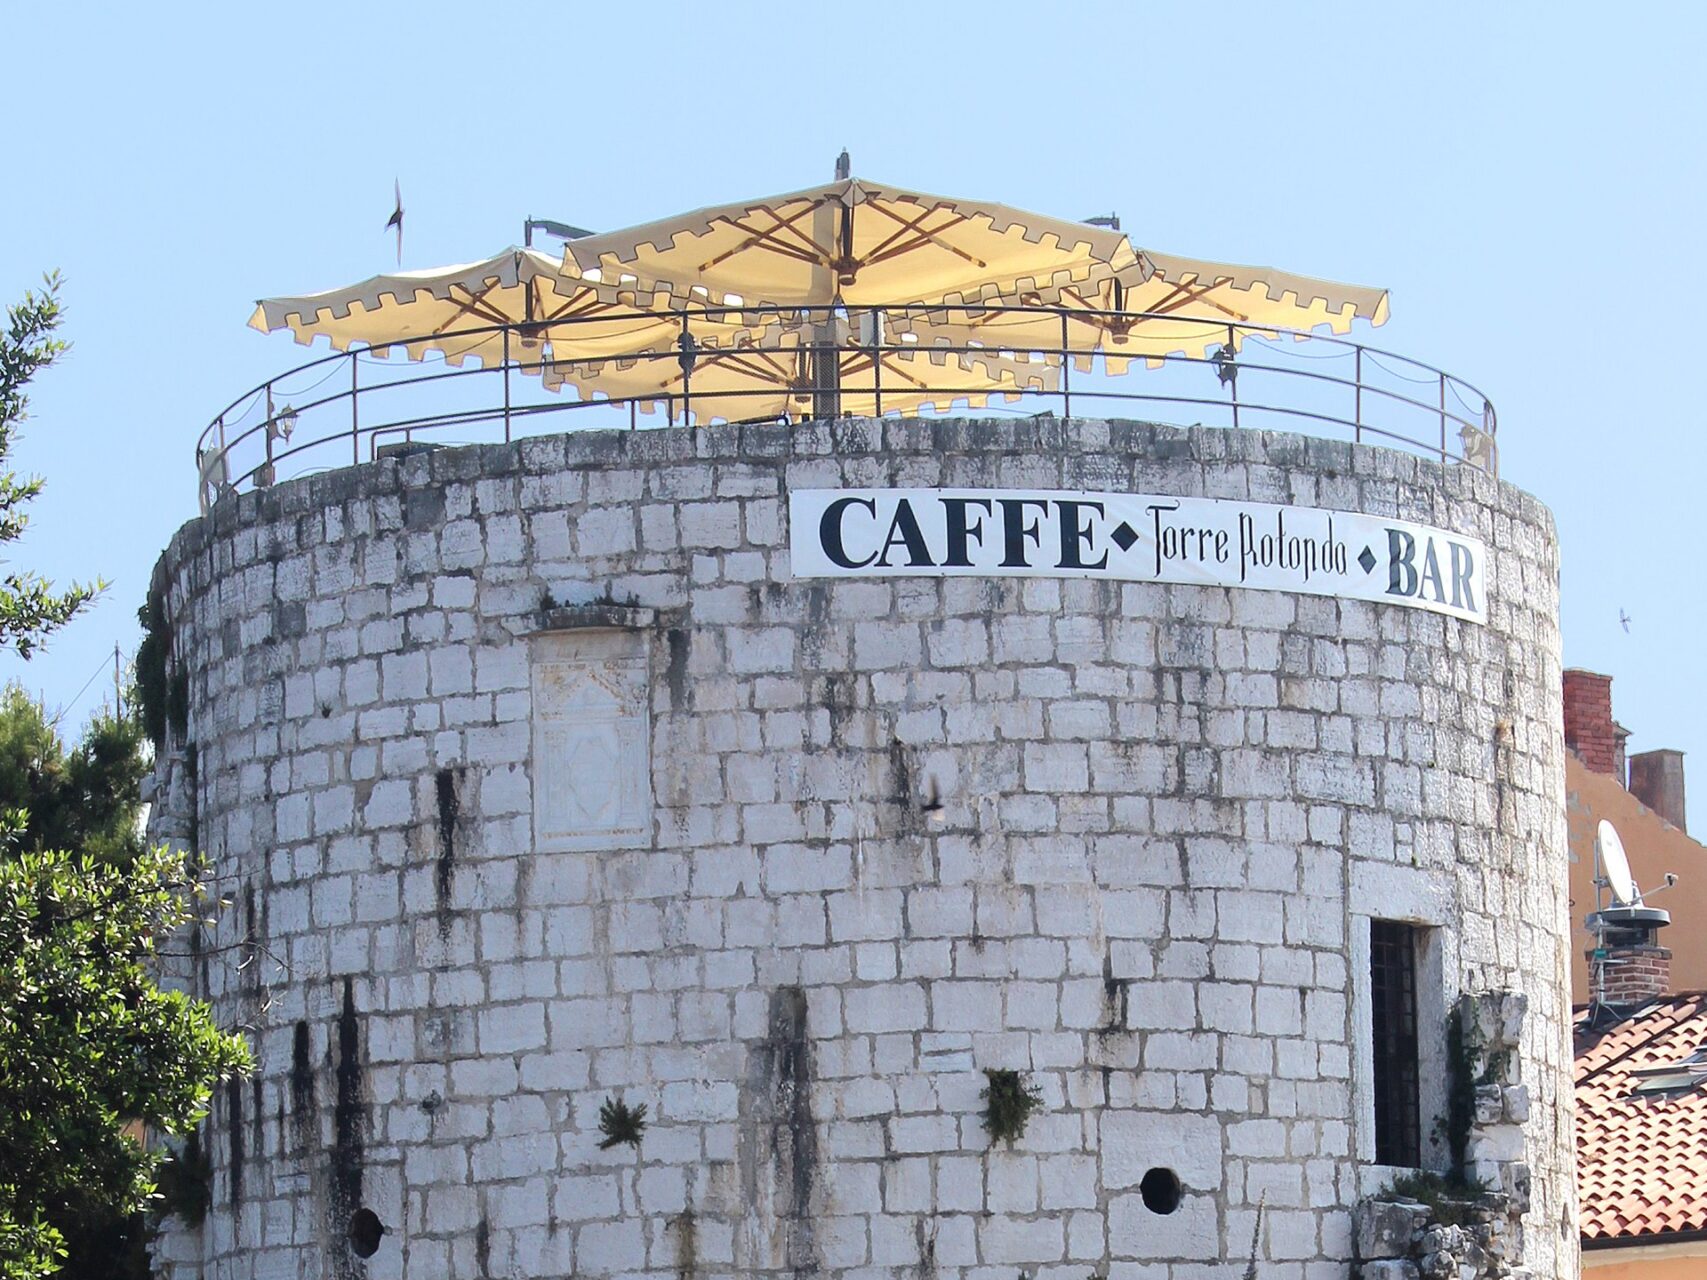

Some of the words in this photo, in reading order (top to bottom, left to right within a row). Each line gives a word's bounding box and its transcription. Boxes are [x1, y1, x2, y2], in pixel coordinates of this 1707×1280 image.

[820, 497, 1109, 570] CAFFE
[1146, 499, 1229, 578] Torre
[1238, 508, 1348, 584] Rotonda
[1384, 527, 1478, 613] BAR
